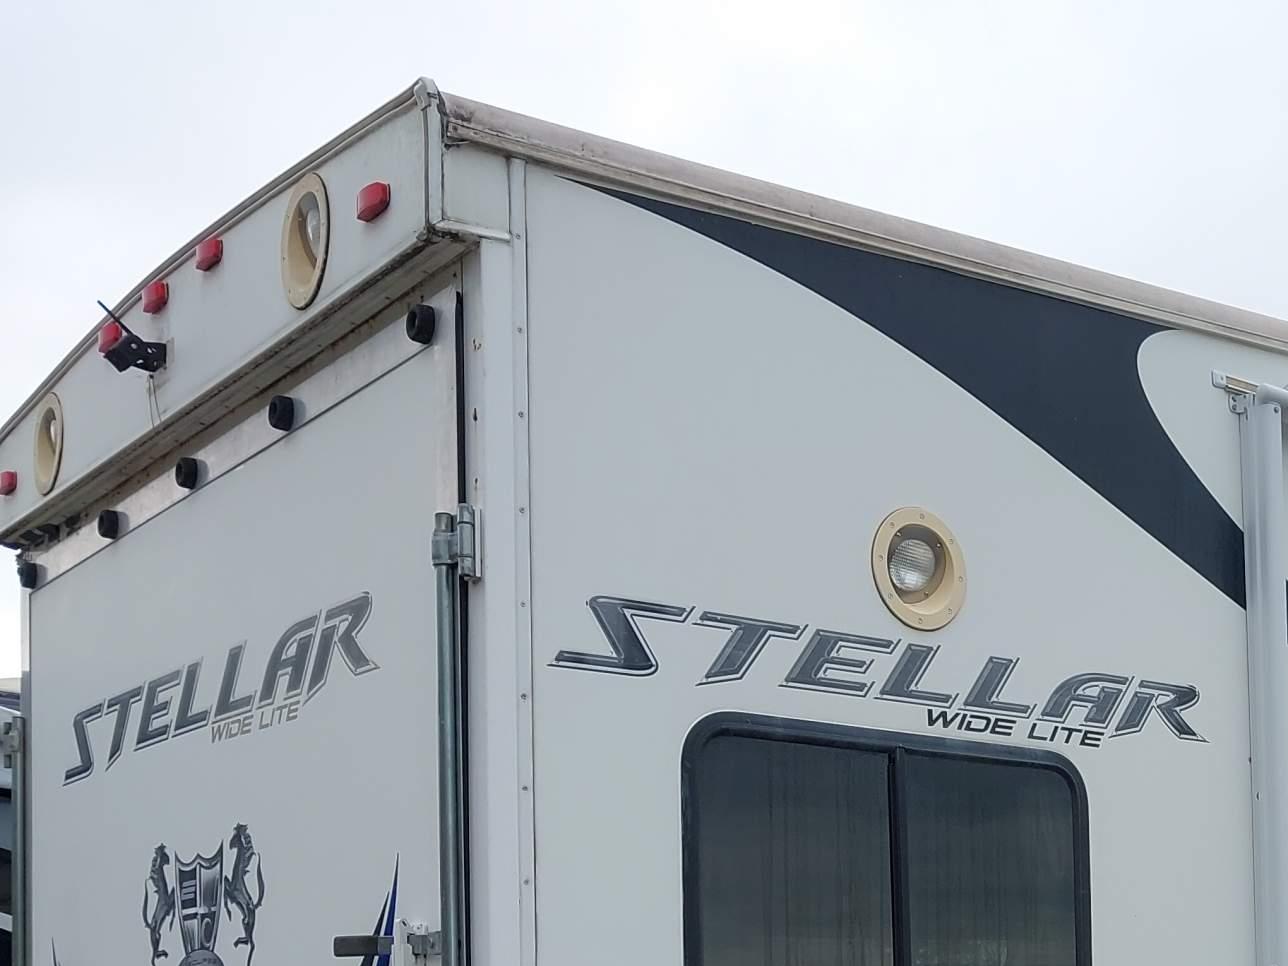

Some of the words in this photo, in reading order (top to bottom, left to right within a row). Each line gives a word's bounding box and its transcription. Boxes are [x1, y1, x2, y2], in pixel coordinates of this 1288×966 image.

[62, 591, 381, 786] STELLAR
[547, 594, 1210, 743] STELLAR
[211, 714, 254, 743] WIDE
[258, 700, 301, 730] LITE
[926, 708, 1018, 737] WIDE
[1027, 722, 1106, 748] LITE
